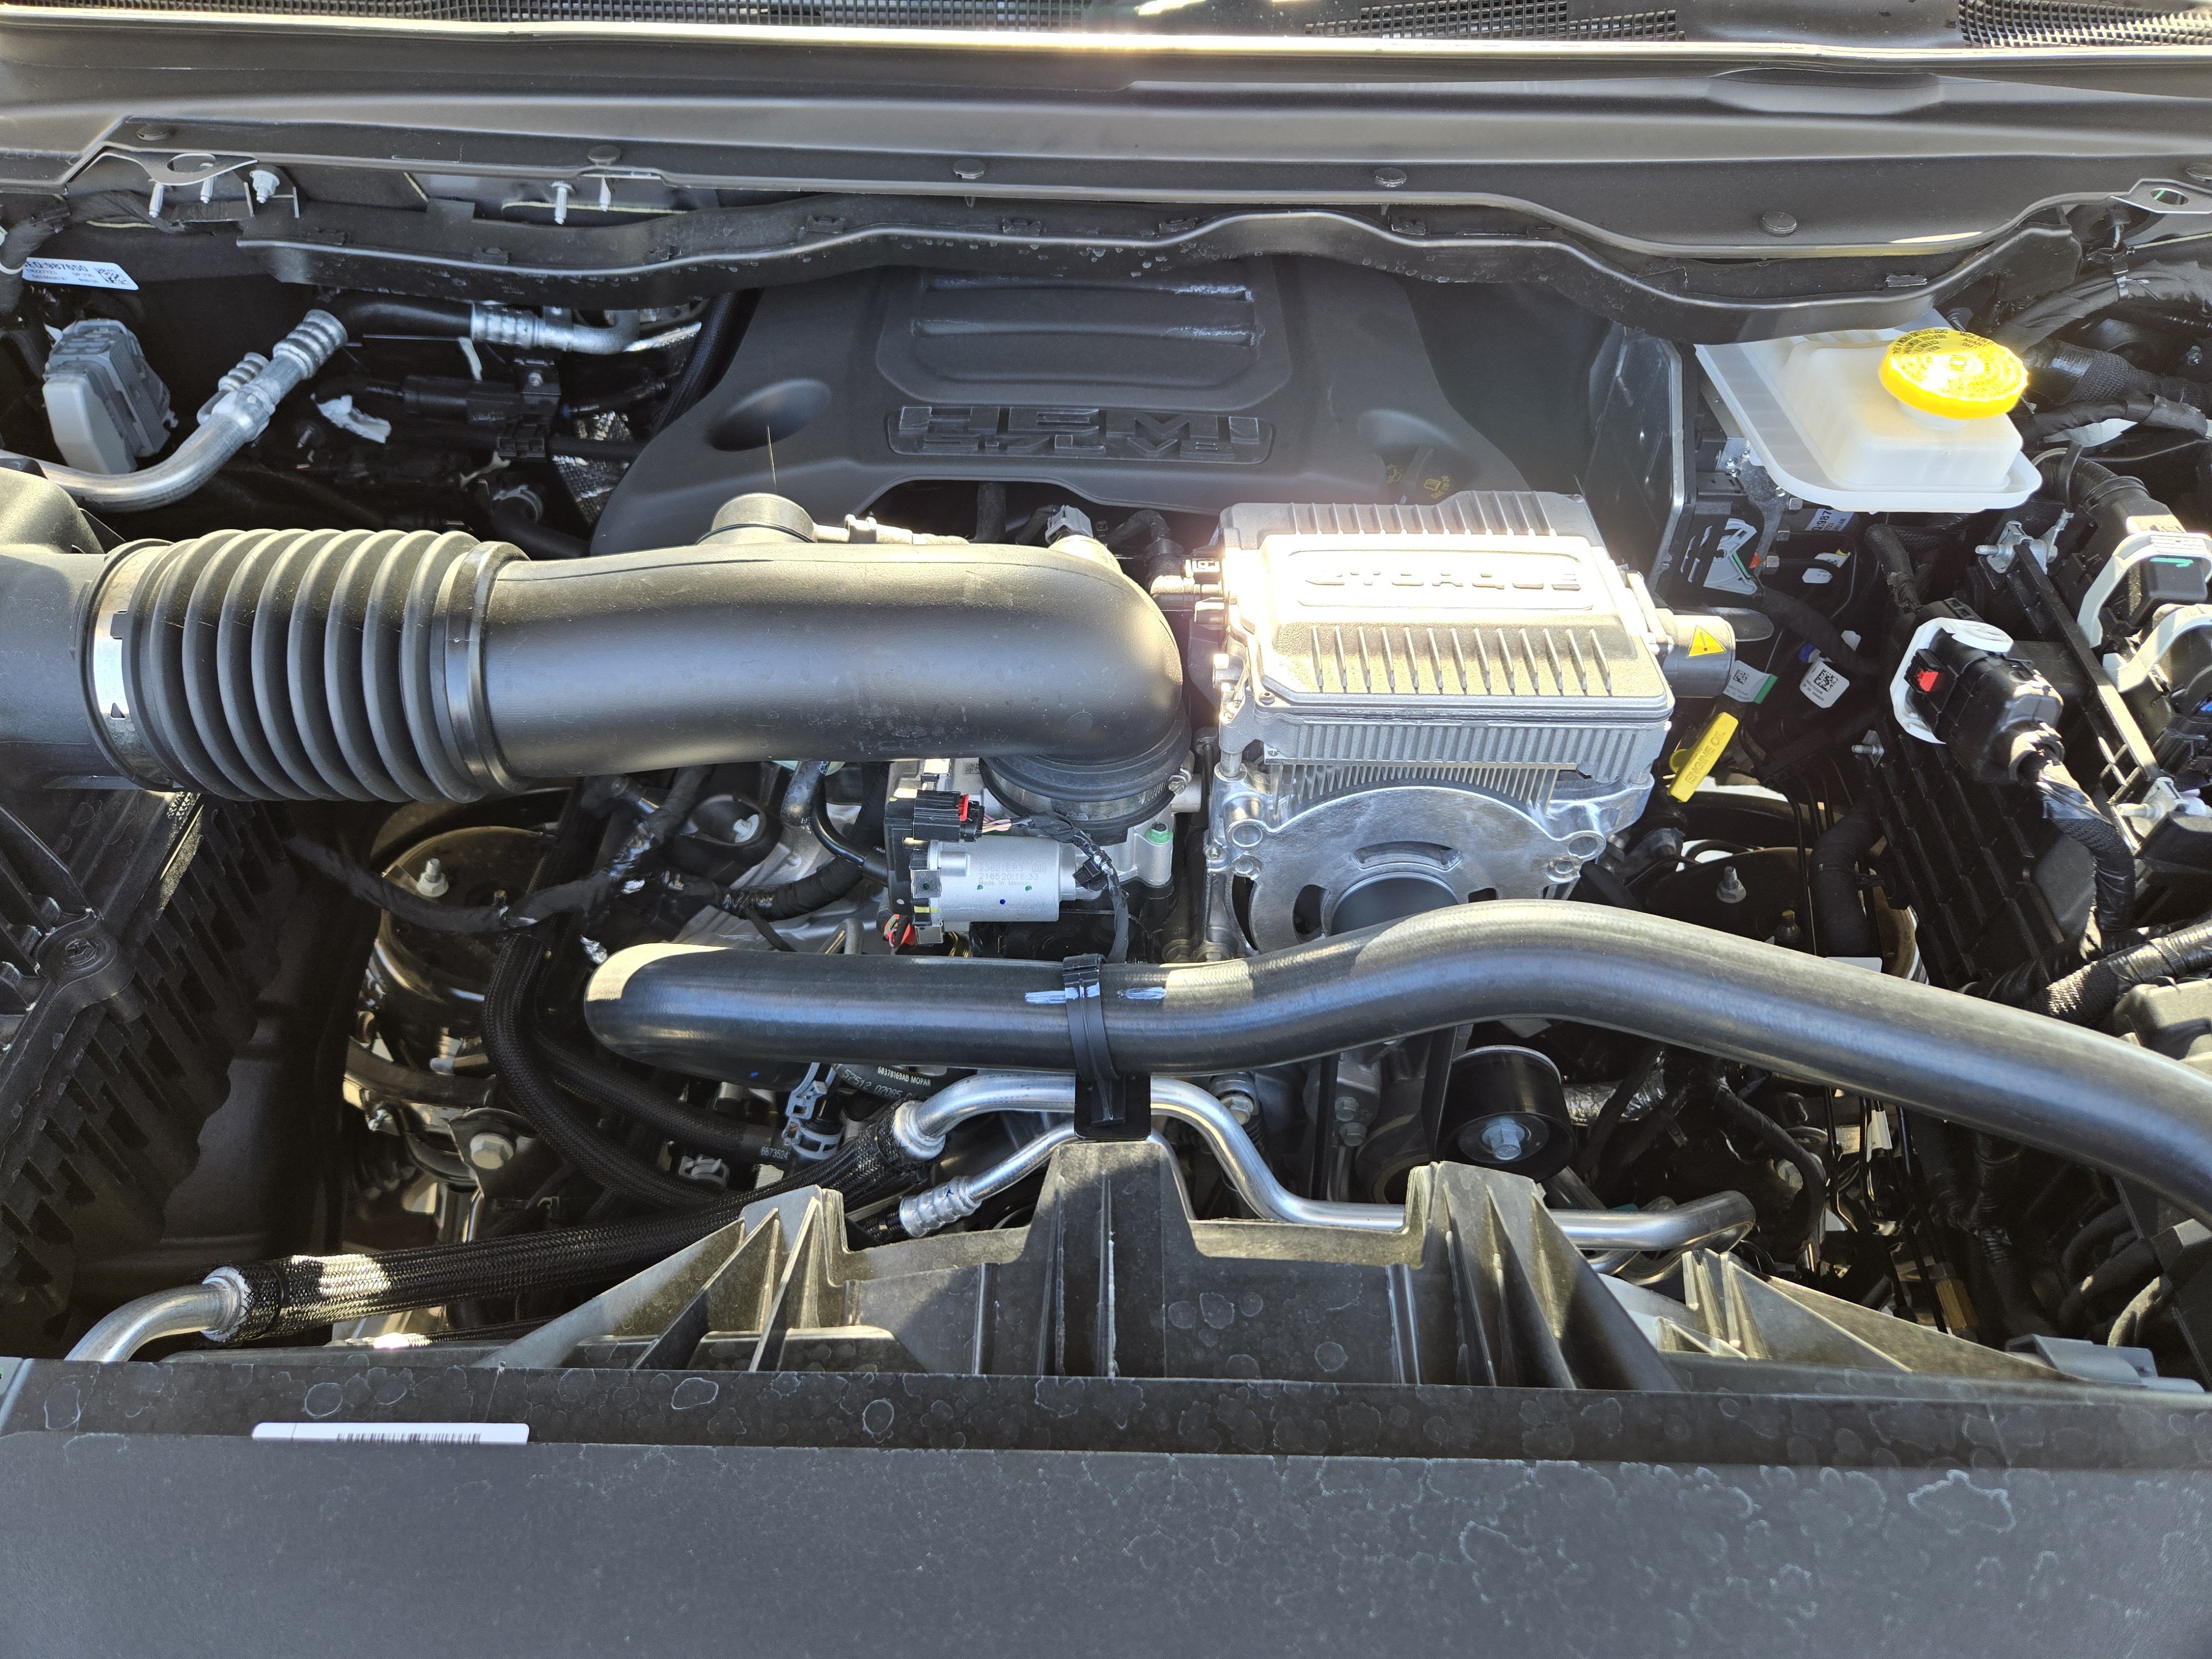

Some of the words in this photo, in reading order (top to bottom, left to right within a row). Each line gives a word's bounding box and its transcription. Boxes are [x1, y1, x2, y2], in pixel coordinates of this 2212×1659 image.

[1910, 329, 1928, 337] FLUID
[1920, 340, 1939, 348] CLEAN
[899, 405, 1260, 444] HEMI
[922, 433, 1106, 456] 5.7L
[1126, 435, 1234, 460] V8
[1684, 745, 1717, 785] ENGINE
[1710, 731, 1726, 747] OIL
[878, 1066, 910, 1082] 68378169AB
[911, 1076, 931, 1087] MOPAR
